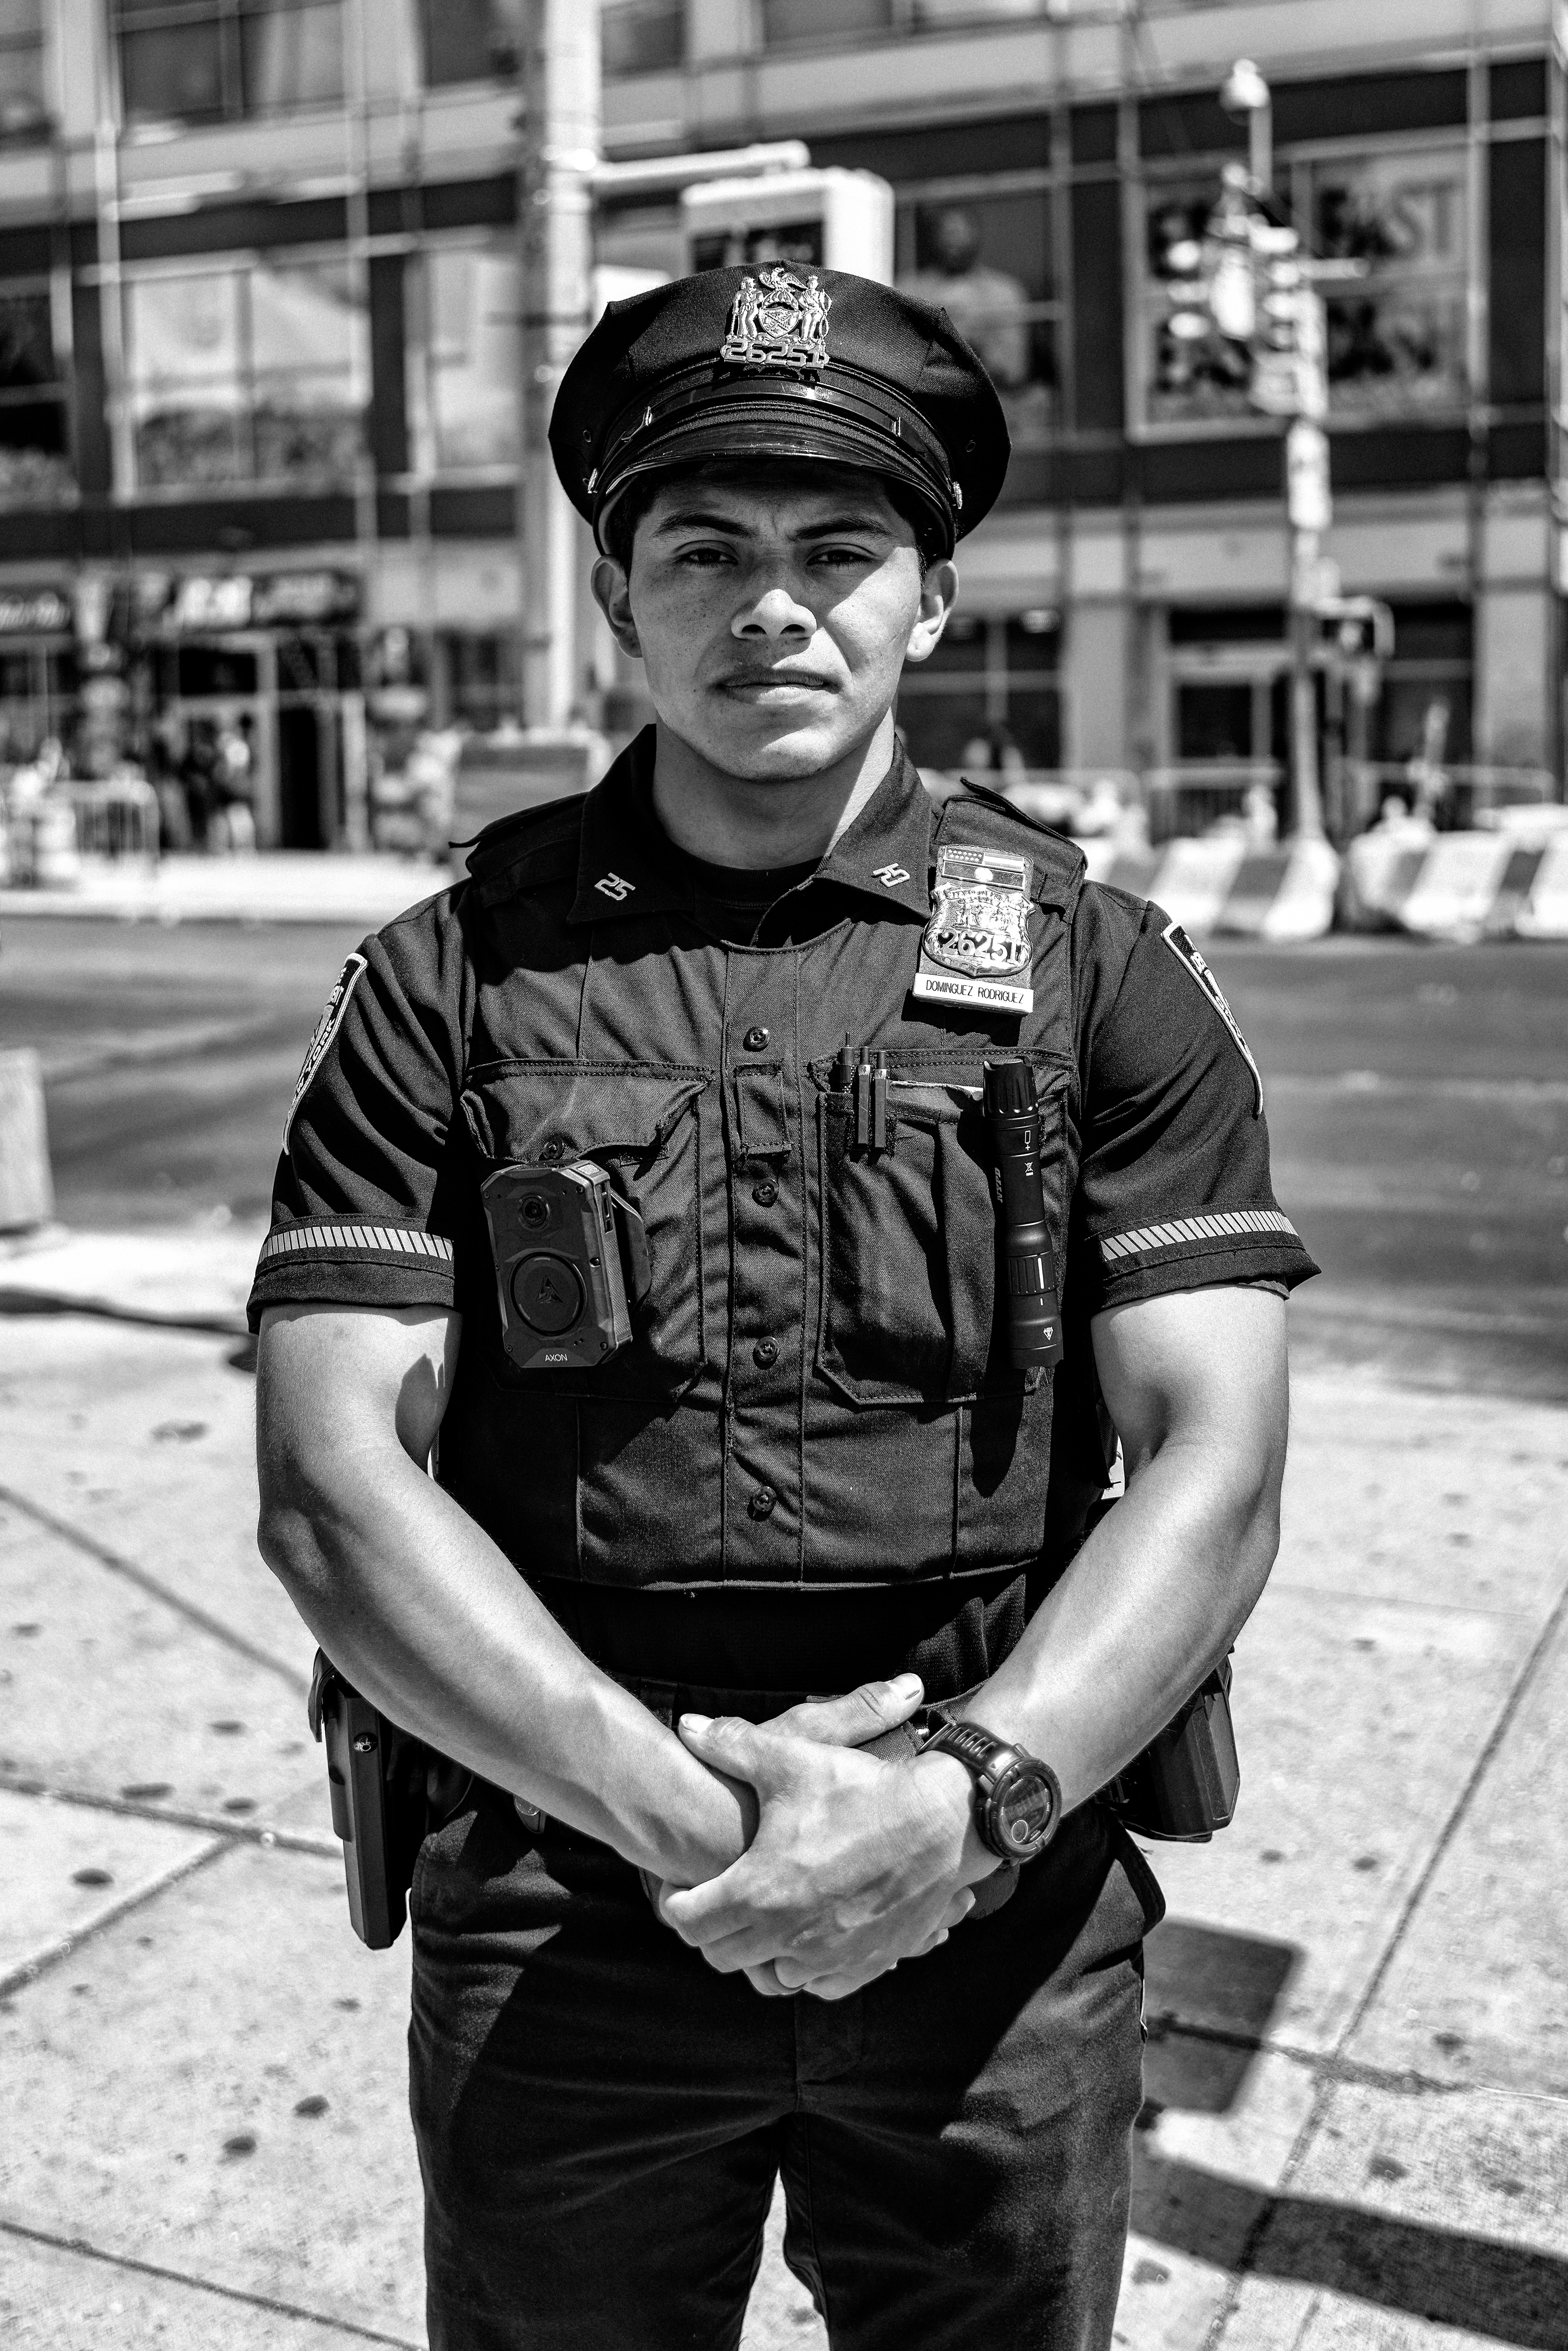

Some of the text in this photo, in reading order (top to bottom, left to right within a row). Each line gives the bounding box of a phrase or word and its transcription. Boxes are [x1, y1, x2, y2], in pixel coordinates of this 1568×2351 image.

[724, 339, 824, 368] 26251
[595, 872, 635, 900] 25
[873, 862, 910, 888] 25
[942, 928, 1020, 966] 26251
[926, 980, 1024, 1004] DOMINGUEZ RODRIGUEZ
[995, 1167, 1003, 1203] NYPD
[545, 1353, 568, 1362] AXON
[1010, 1778, 1024, 1790] TACTICAL
[1030, 1830, 1040, 1841] GARMIN
